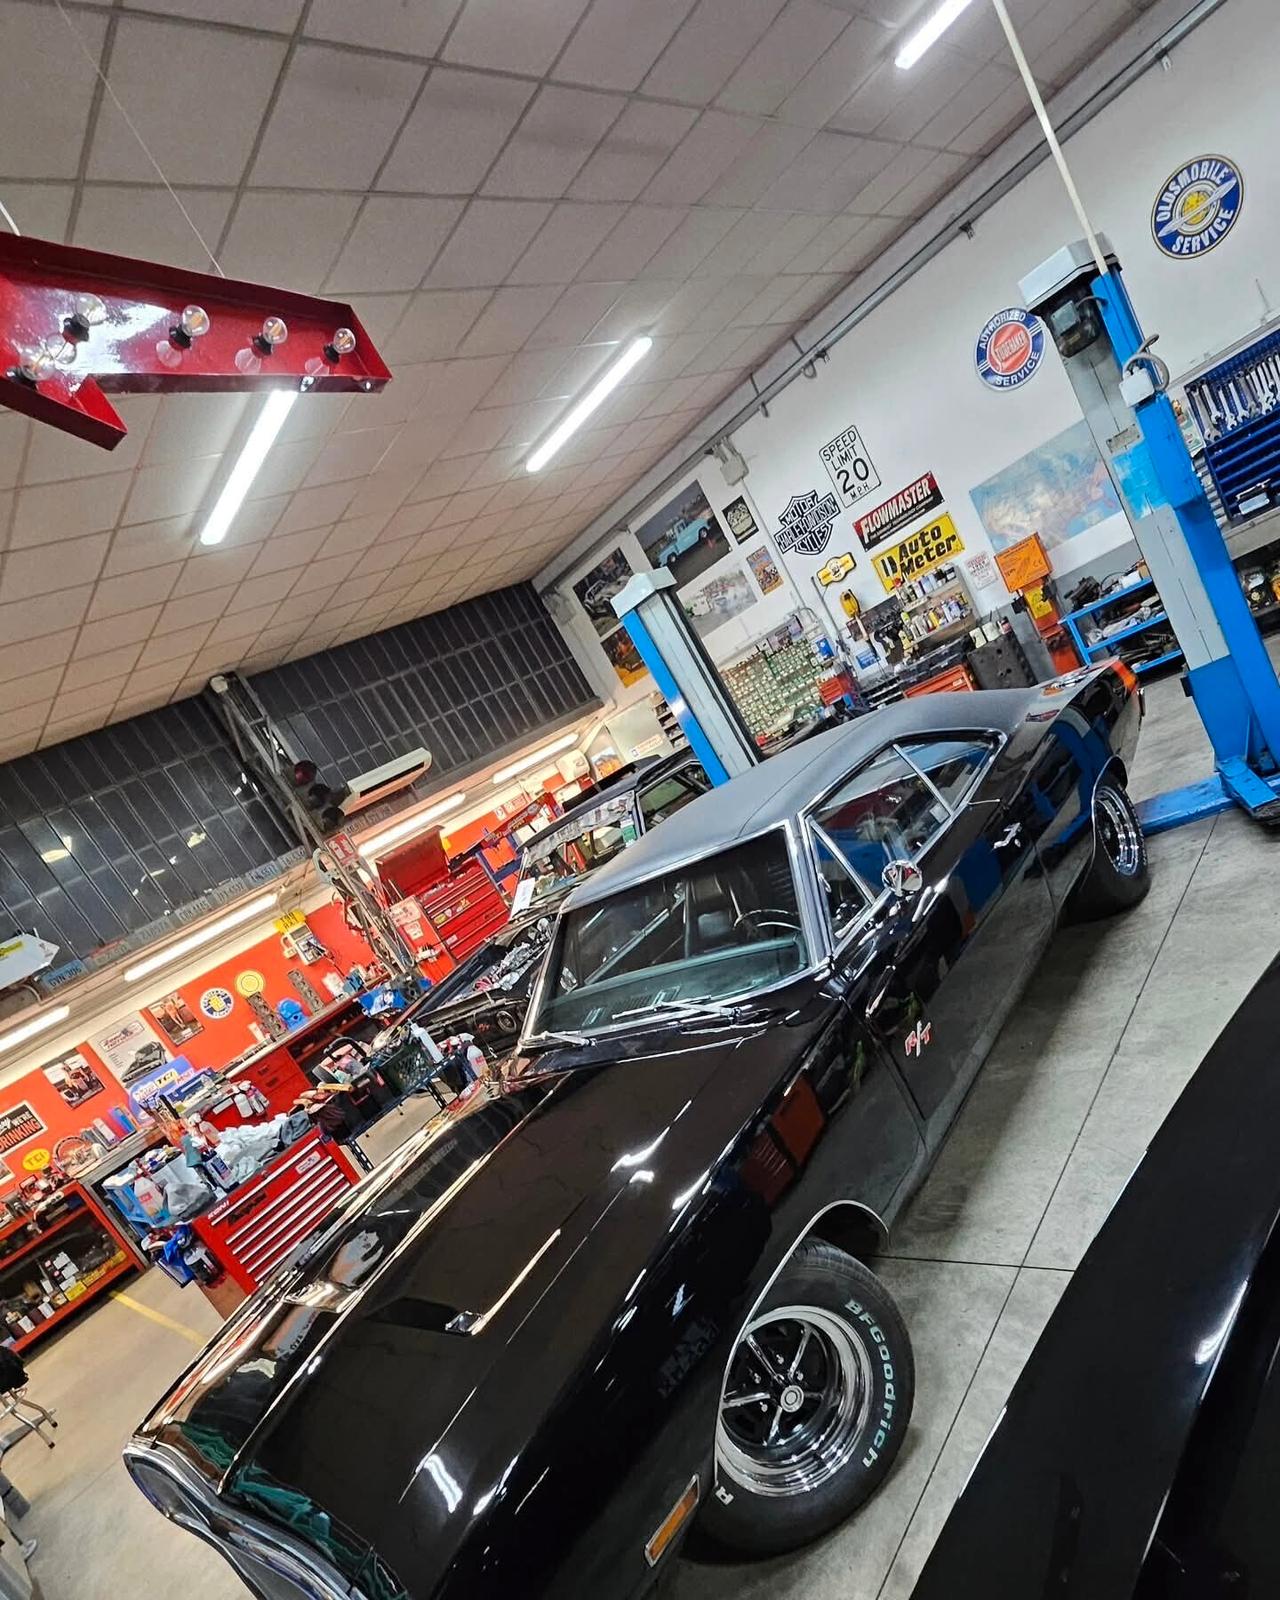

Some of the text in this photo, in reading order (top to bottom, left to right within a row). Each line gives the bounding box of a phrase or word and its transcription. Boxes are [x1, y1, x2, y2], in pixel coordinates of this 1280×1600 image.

[1156, 159, 1230, 223] OLDSMOBILE
[1172, 208, 1234, 255] SERVICE
[979, 310, 1026, 350] AUTHORIZED
[995, 351, 1040, 386] SERVICE
[823, 430, 857, 462] SPEED
[831, 444, 859, 471] LIMIT
[837, 457, 870, 494] 20
[850, 483, 870, 500] MPH
[777, 497, 838, 550] HARLEY-DAVIDSON
[785, 496, 818, 525] MOTOR
[861, 478, 932, 544] FLOWMASTER
[797, 524, 831, 553] CYCLES
[898, 525, 943, 559] Auto
[899, 533, 956, 581] Meter
[905, 1020, 930, 1056] R/T
[845, 1299, 896, 1468] BFGoodrich
